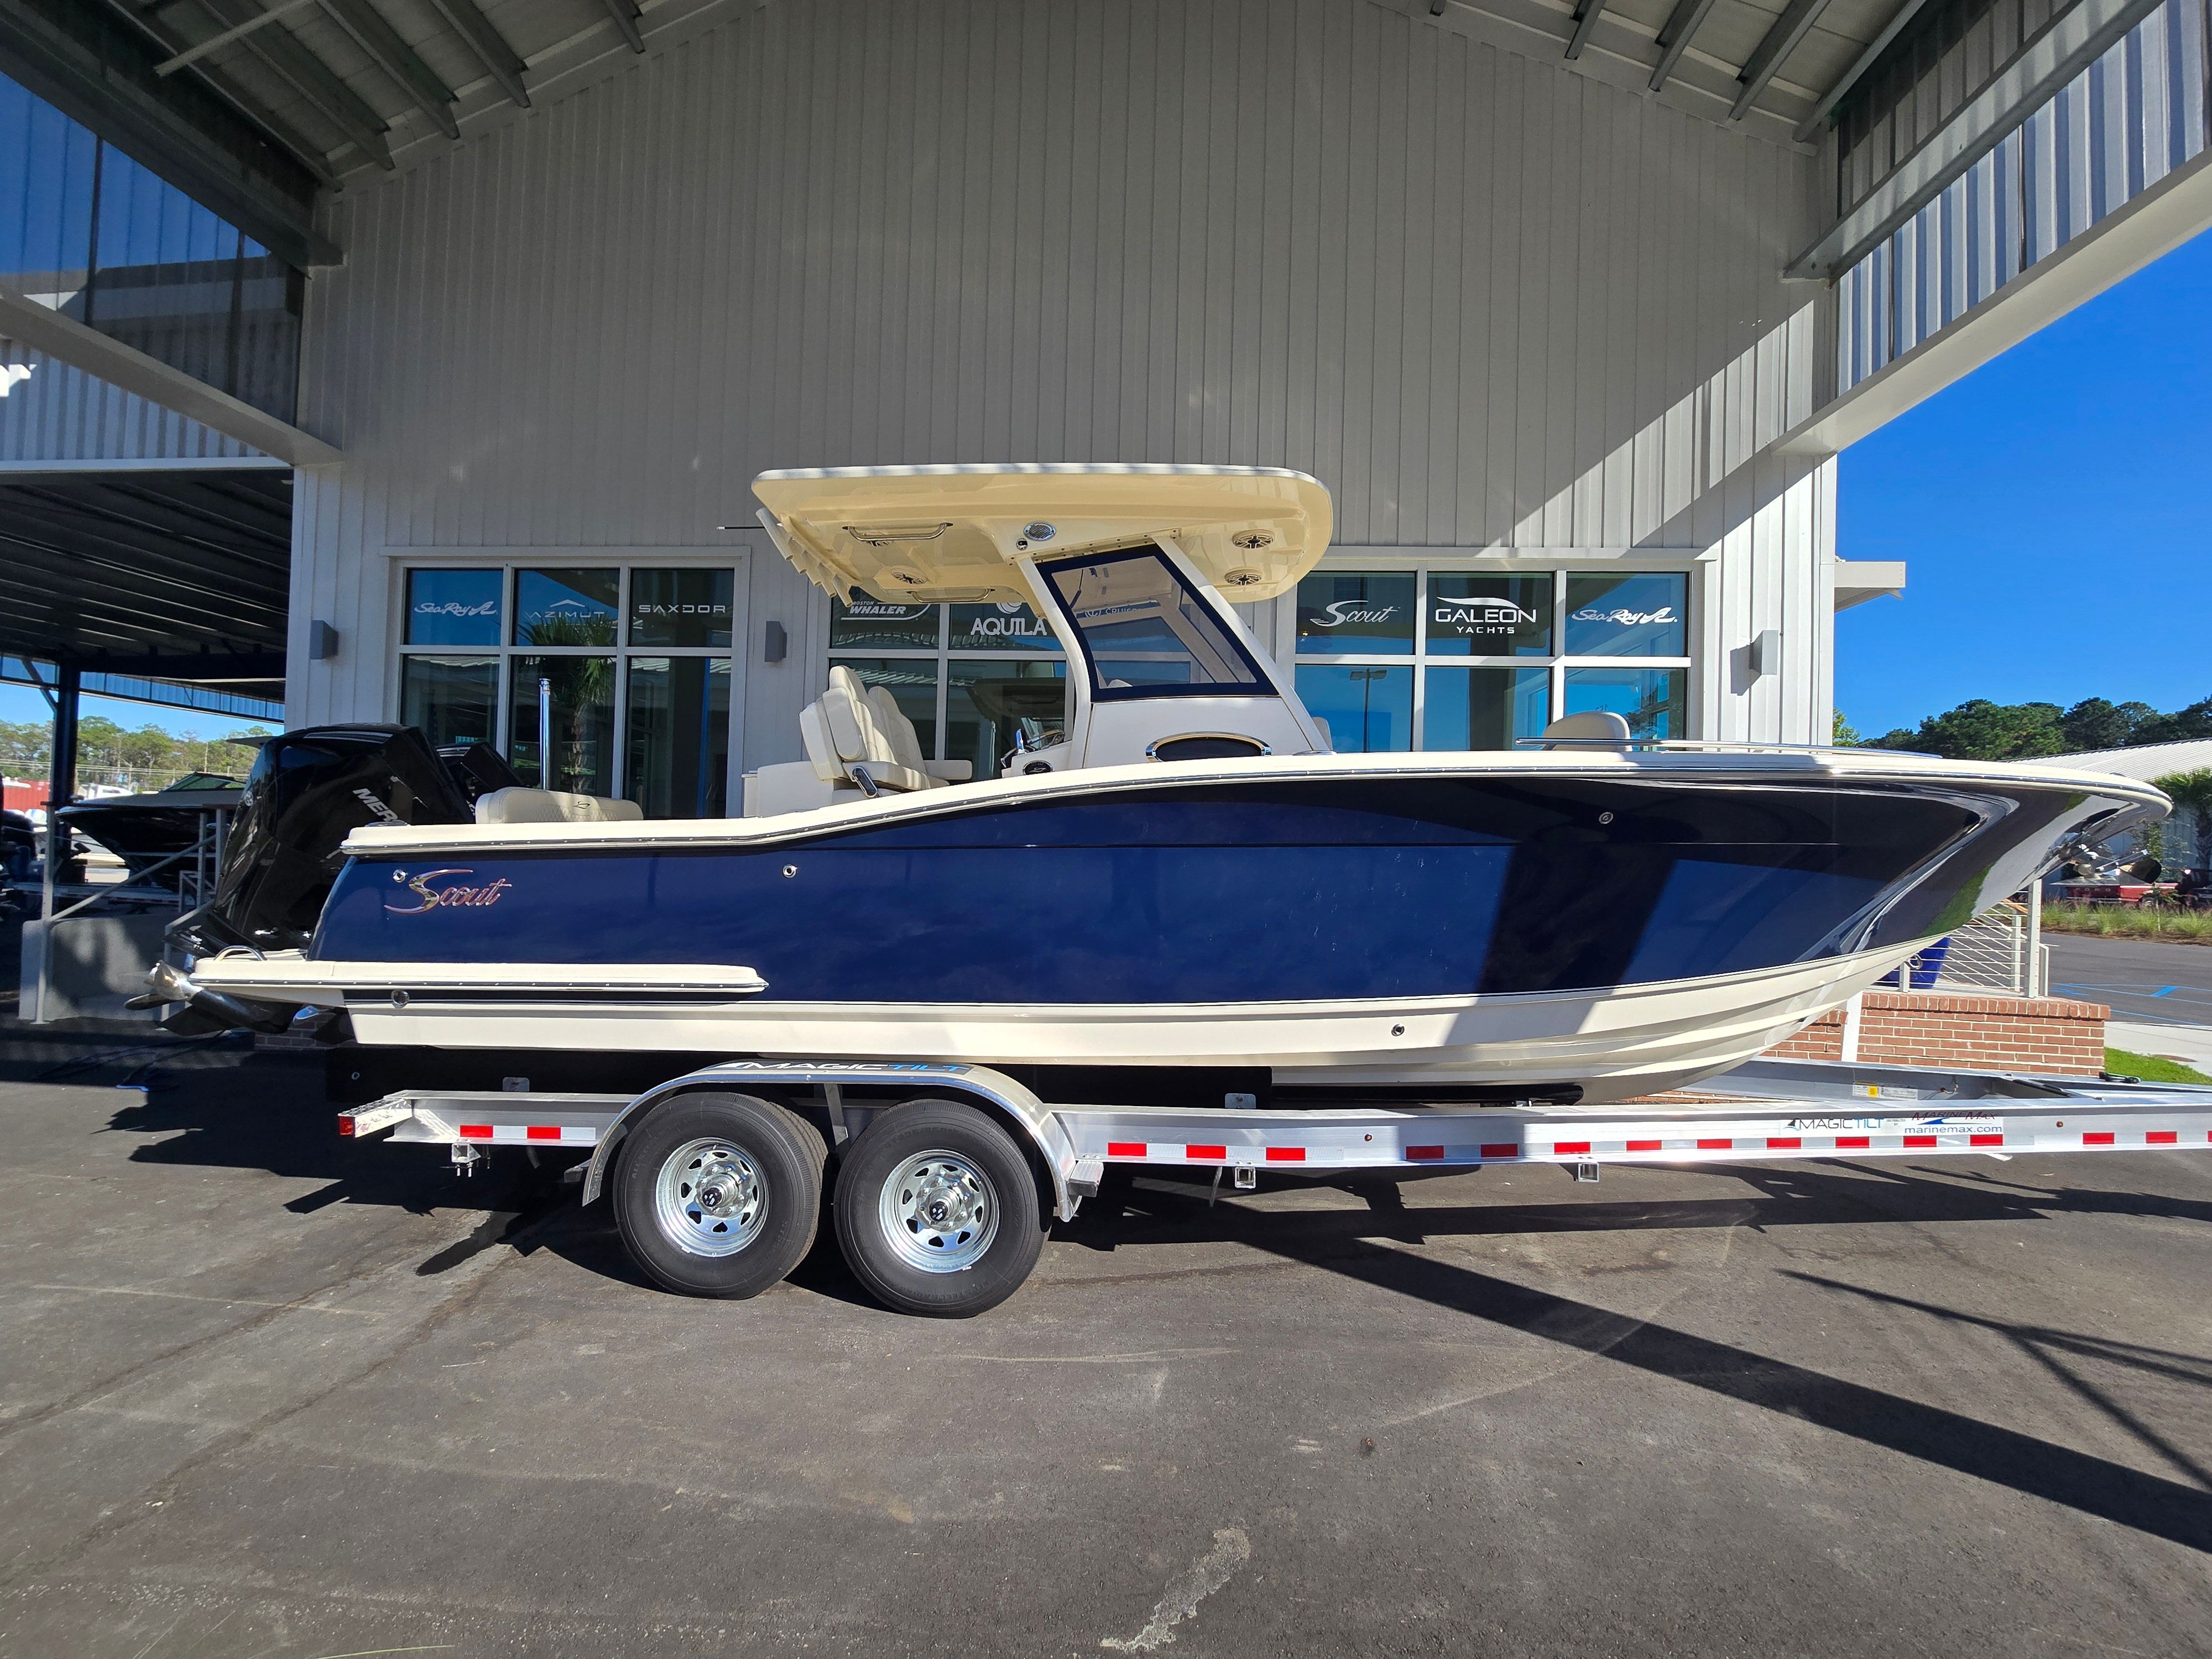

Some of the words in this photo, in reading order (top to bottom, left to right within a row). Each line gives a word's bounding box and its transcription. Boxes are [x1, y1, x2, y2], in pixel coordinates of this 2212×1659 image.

[414, 603, 444, 613] Sea
[442, 602, 471, 617] Ray
[639, 604, 726, 613] SAXDOR
[850, 606, 906, 614] WHALER
[1310, 600, 1398, 627] Scout
[1435, 608, 1536, 623] GALEON
[1572, 609, 1609, 621] Sea
[1606, 609, 1644, 625] Ray
[971, 618, 1047, 636] AQUILA
[1456, 626, 1515, 634] YACHTS
[353, 788, 407, 823] MER
[384, 869, 512, 914] Scout
[1905, 1125, 2002, 1134] marinemax.com
